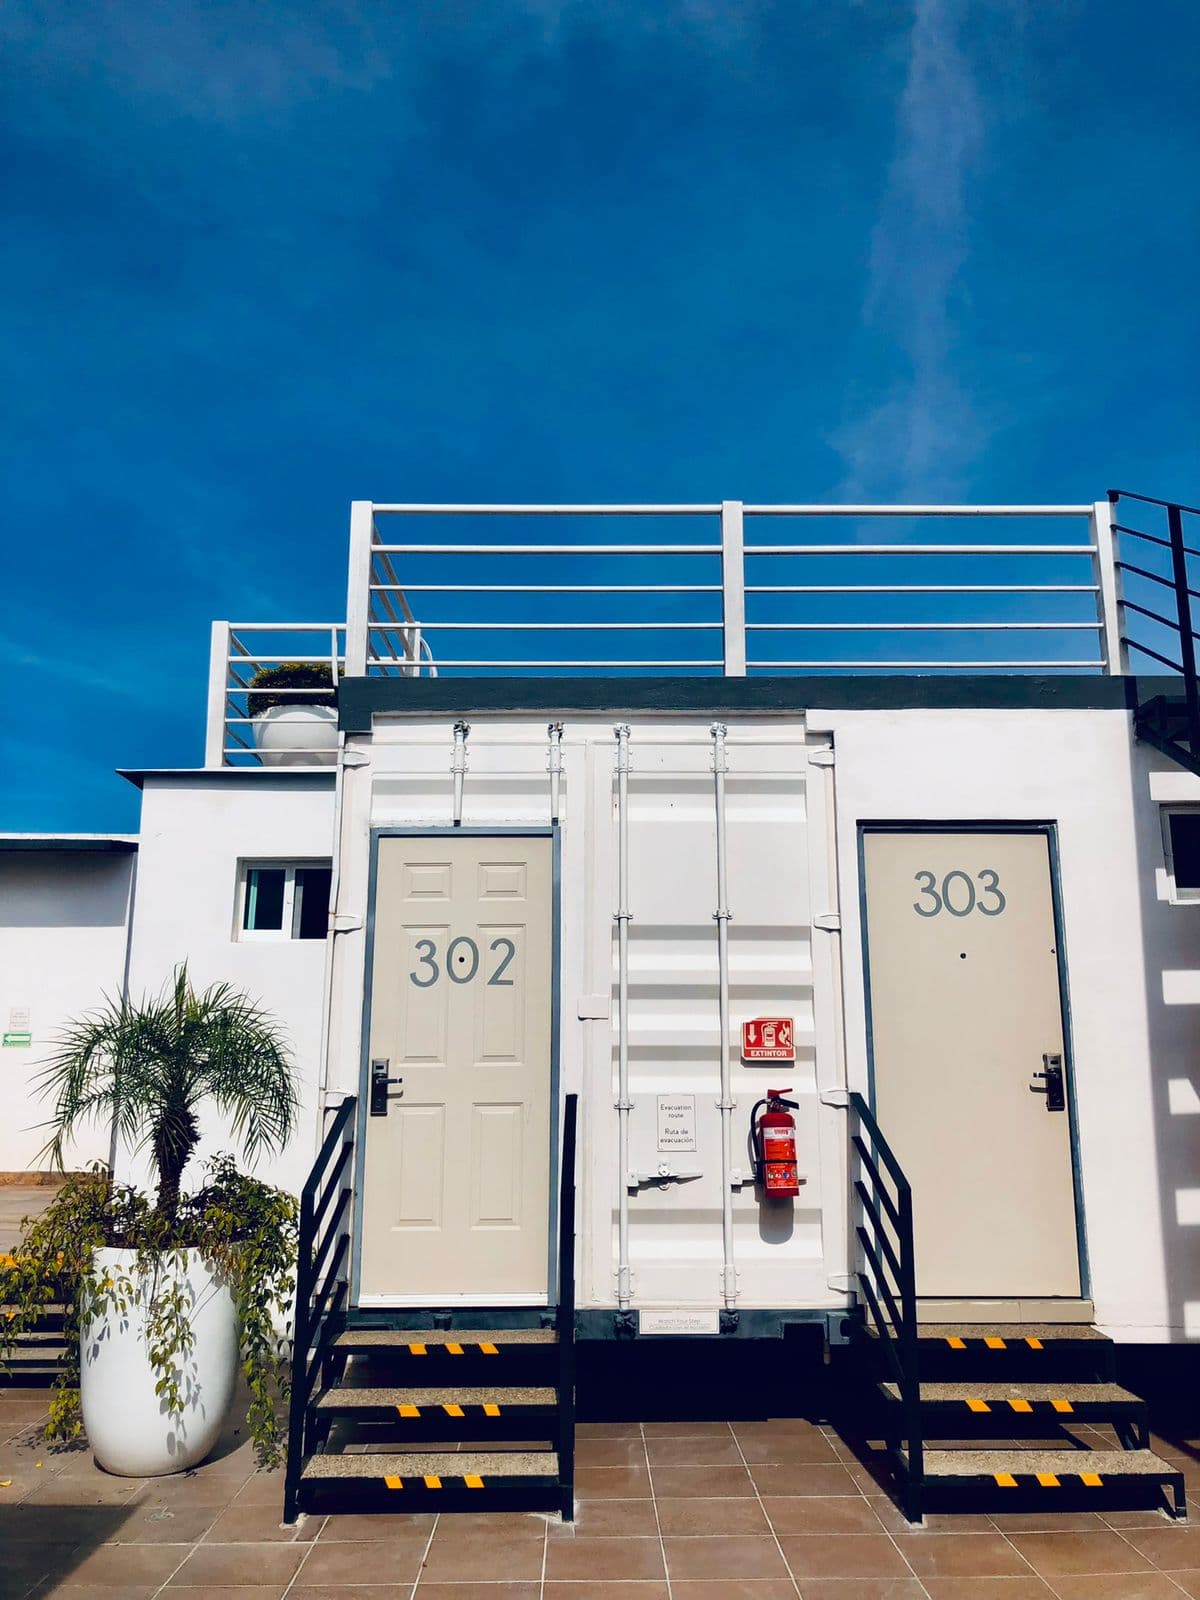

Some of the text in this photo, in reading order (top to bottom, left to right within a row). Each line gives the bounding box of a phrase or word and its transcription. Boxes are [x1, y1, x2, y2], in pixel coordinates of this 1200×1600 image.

[913, 869, 1006, 917] 303
[409, 936, 516, 987] 302
[660, 1103, 692, 1111] Evacuation
[664, 1127, 679, 1135] Ruta
